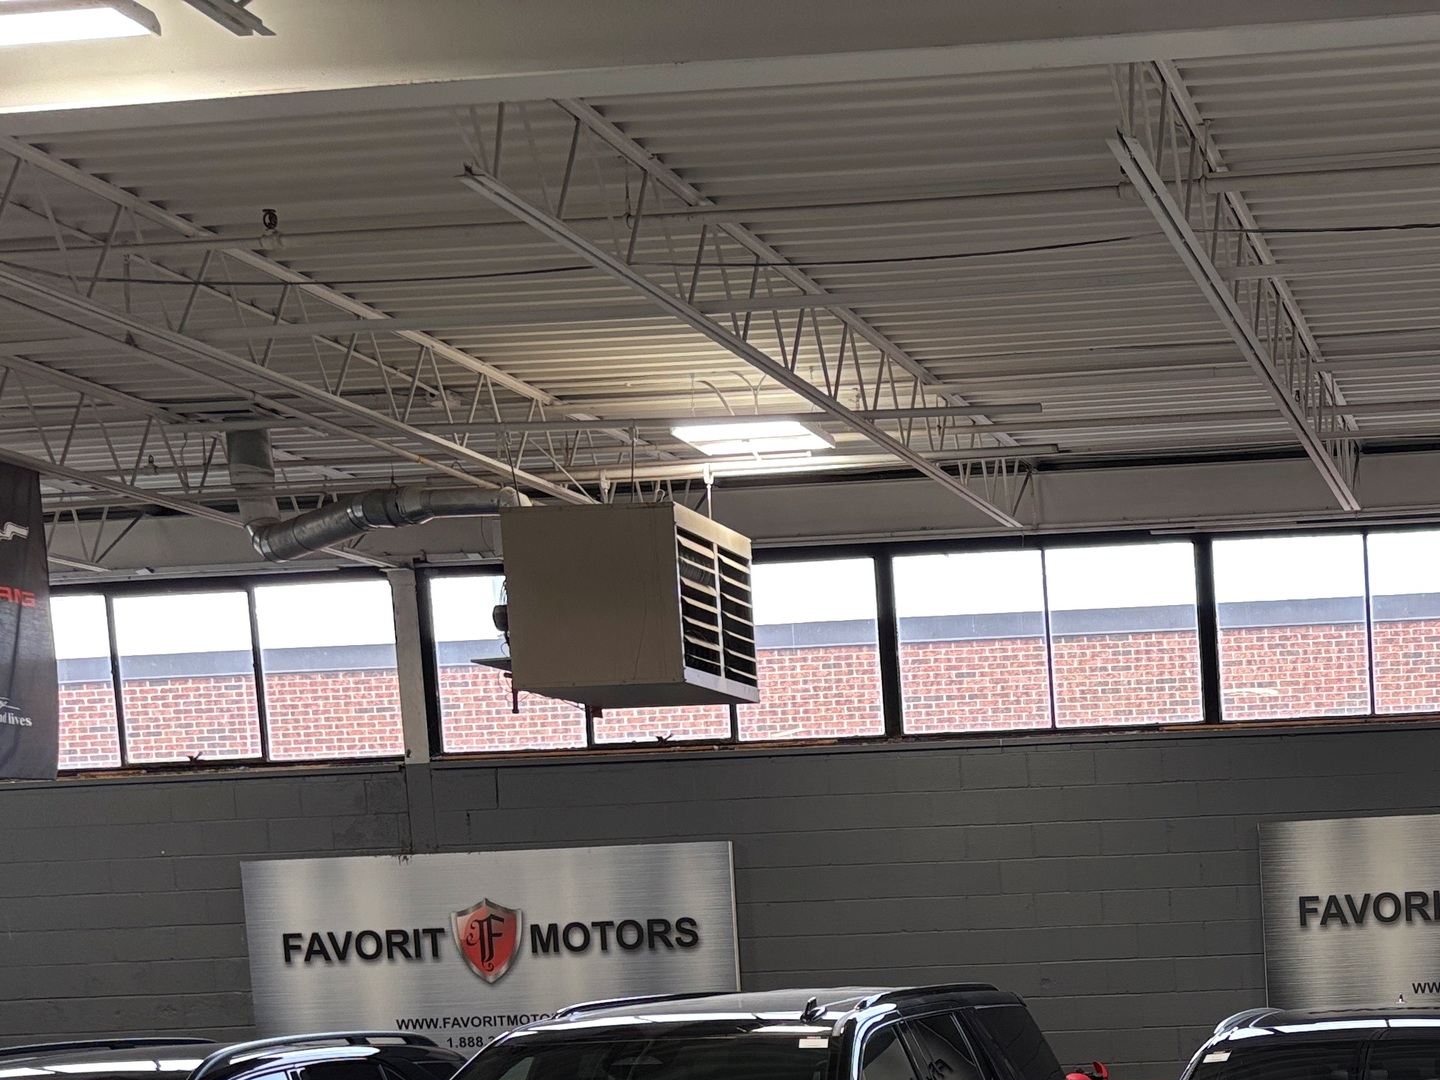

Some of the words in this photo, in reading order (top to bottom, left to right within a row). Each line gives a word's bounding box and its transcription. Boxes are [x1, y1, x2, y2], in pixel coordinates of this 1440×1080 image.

[8, 712, 33, 726] lives
[282, 927, 445, 965] FAVORIT
[530, 917, 700, 955] MOTORS
